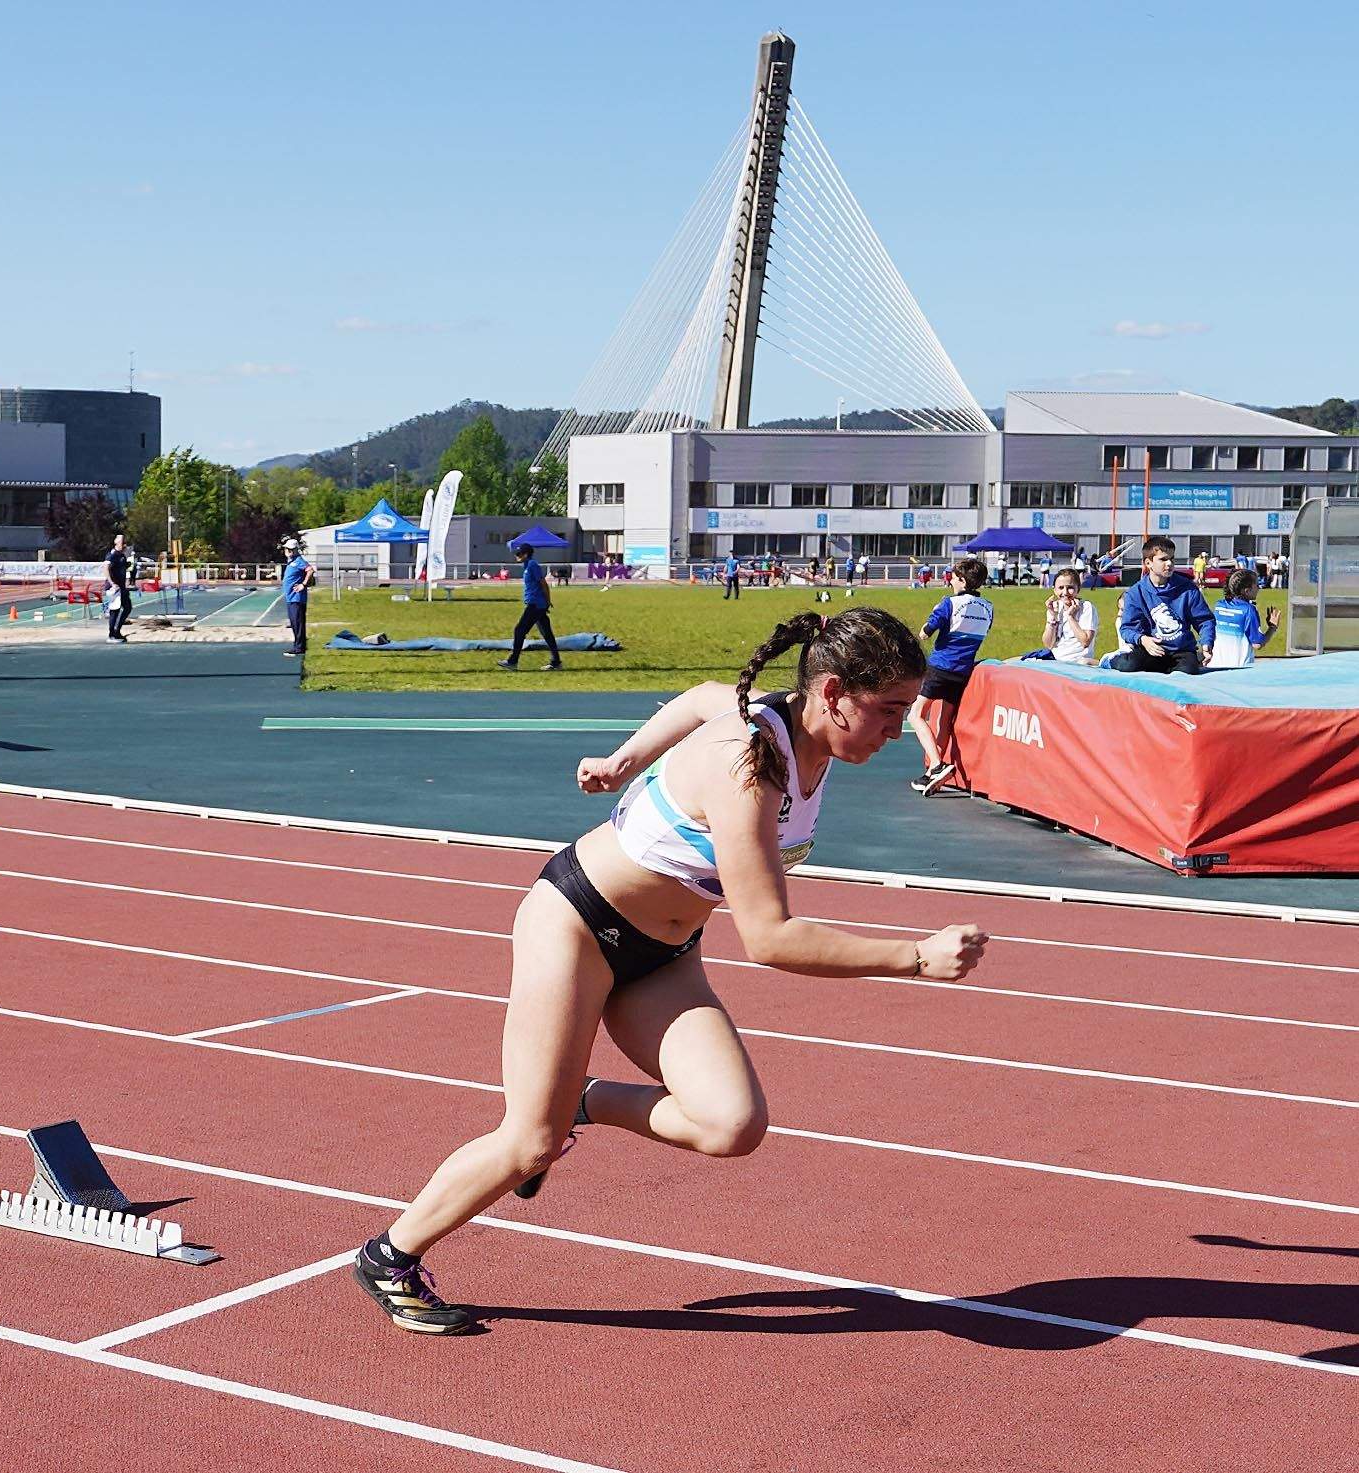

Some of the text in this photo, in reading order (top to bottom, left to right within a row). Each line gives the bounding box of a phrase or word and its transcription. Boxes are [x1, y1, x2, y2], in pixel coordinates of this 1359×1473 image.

[927, 520, 957, 528] GALICIA
[1046, 520, 1089, 528] DE GALICIA
[992, 704, 1045, 749] DIMA
